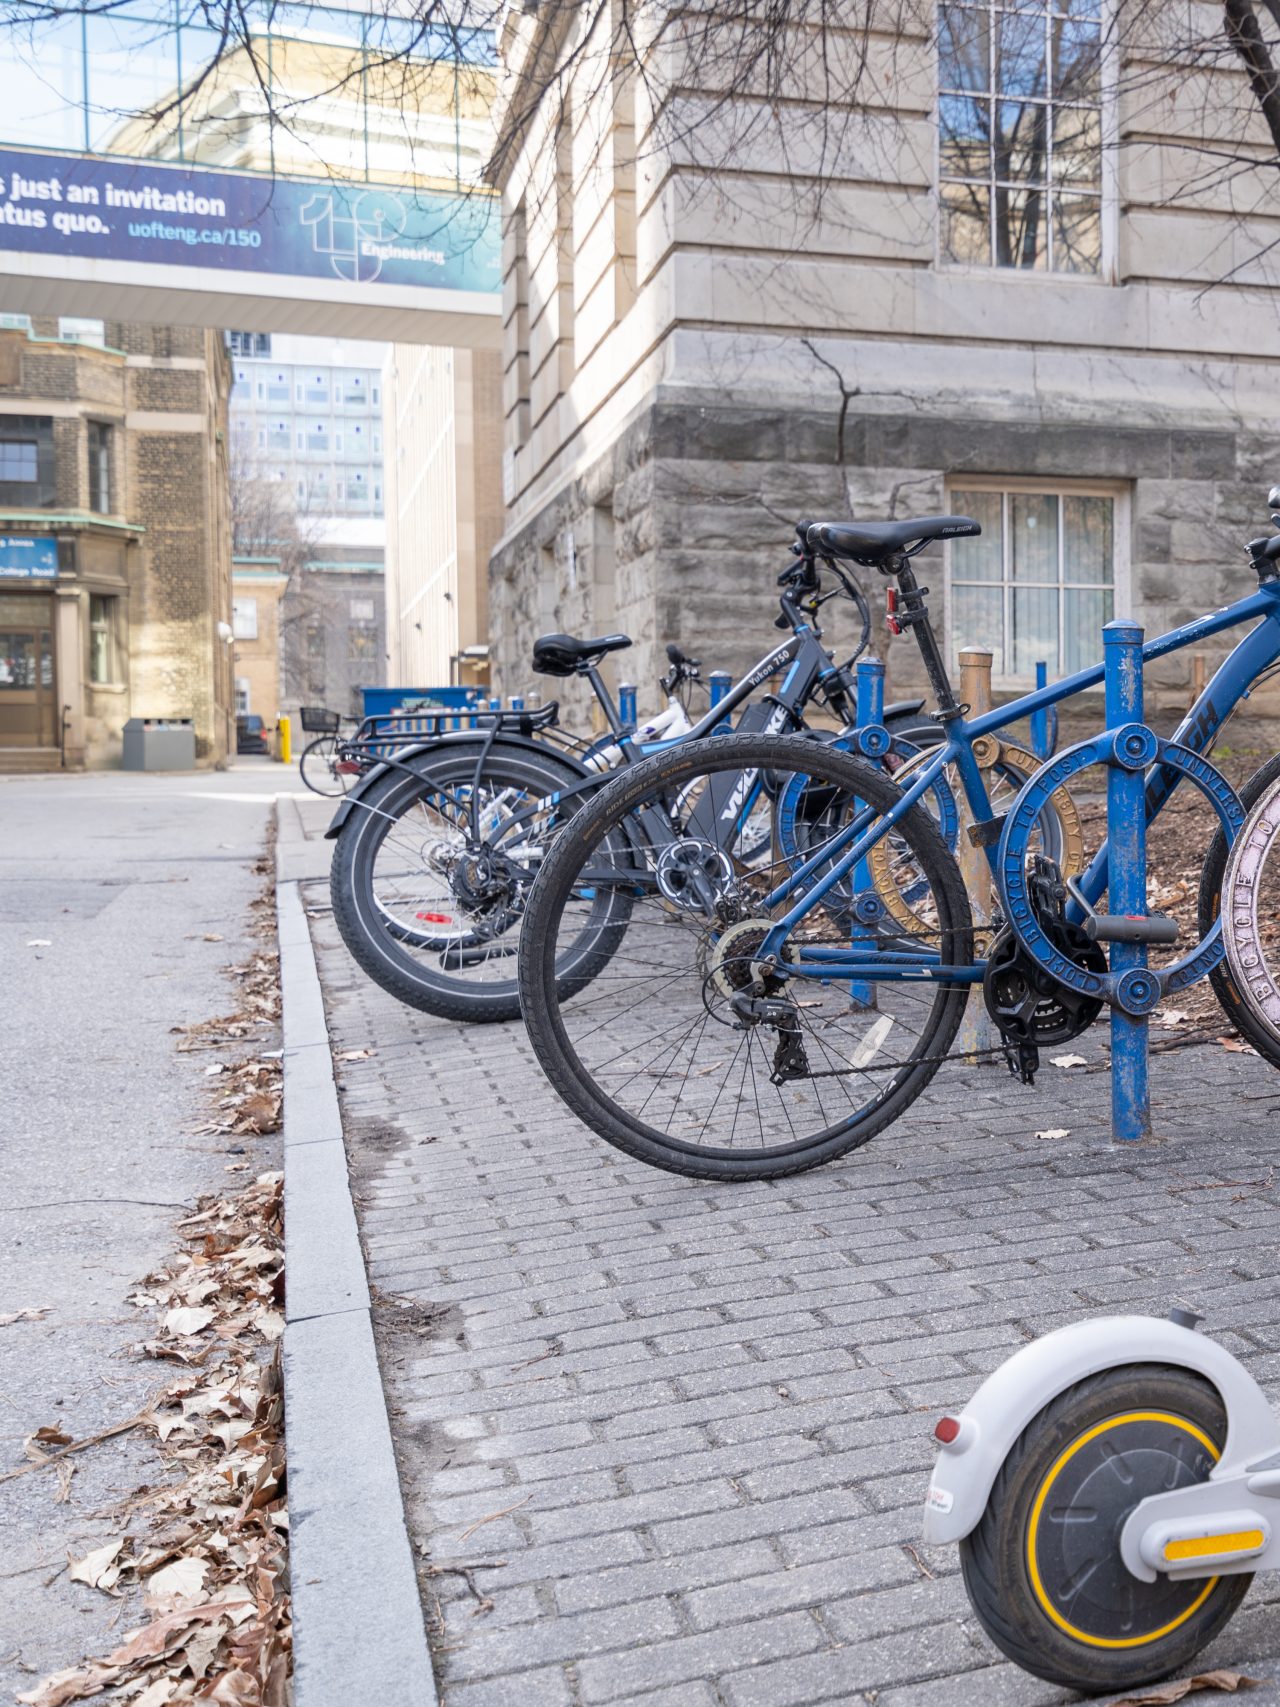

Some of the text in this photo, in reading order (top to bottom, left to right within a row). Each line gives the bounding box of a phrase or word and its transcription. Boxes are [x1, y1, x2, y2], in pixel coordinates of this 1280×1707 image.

[9, 173, 62, 201] just
[67, 183, 99, 205] an
[105, 182, 226, 217] invitation
[52, 211, 110, 235] quo.
[128, 221, 261, 248] uofteng.ca/150
[361, 241, 446, 265] Engineering
[749, 650, 790, 687] Yukon 750
[1177, 750, 1244, 827] UNIVERSI
[1249, 819, 1274, 850] TO
[1006, 753, 1088, 988] LOCK BICYCLE TO POST
[1234, 873, 1274, 1001] BICYCLE
[869, 955, 924, 965] RALEIGH
